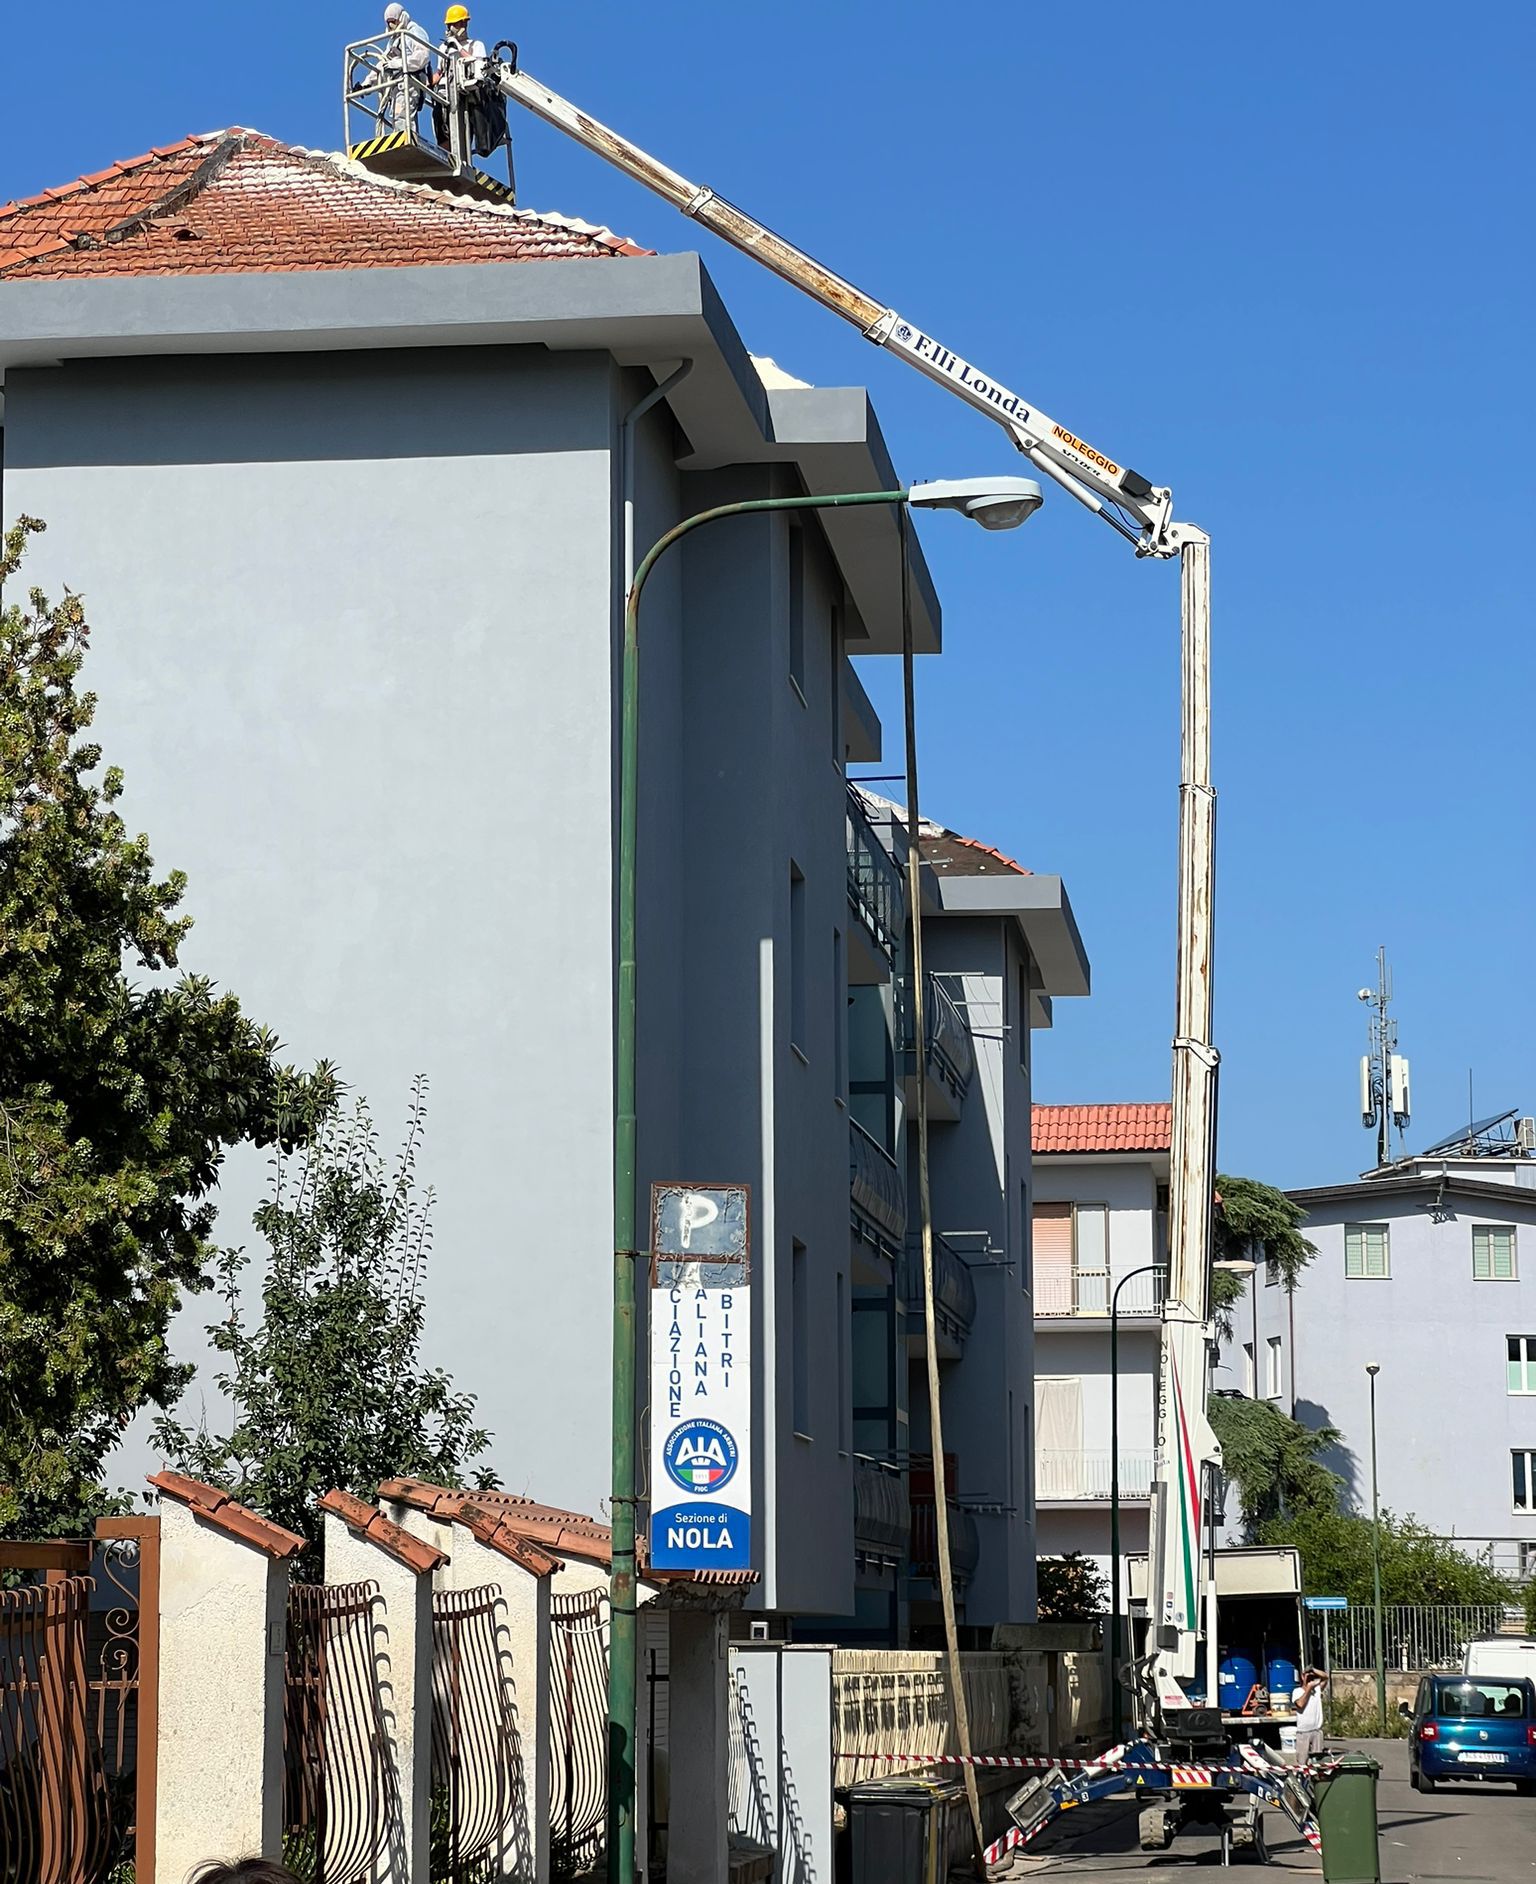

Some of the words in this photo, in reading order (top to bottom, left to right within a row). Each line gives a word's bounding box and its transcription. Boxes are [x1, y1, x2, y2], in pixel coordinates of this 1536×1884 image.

[914, 335, 957, 372] F.lli
[959, 365, 1030, 423] Londa
[1053, 426, 1118, 475] NOLEGGIO
[721, 1288, 733, 1388] BITRI
[1157, 1340, 1168, 1447] NOLEGGIO
[666, 1422, 696, 1457] ASSOCIAZIONE
[696, 1421, 724, 1435] ITALIANA
[674, 1436, 728, 1466] AIA
[667, 1527, 734, 1549] NOLA
[675, 1513, 716, 1523] Sezione
[718, 1512, 728, 1523] di
